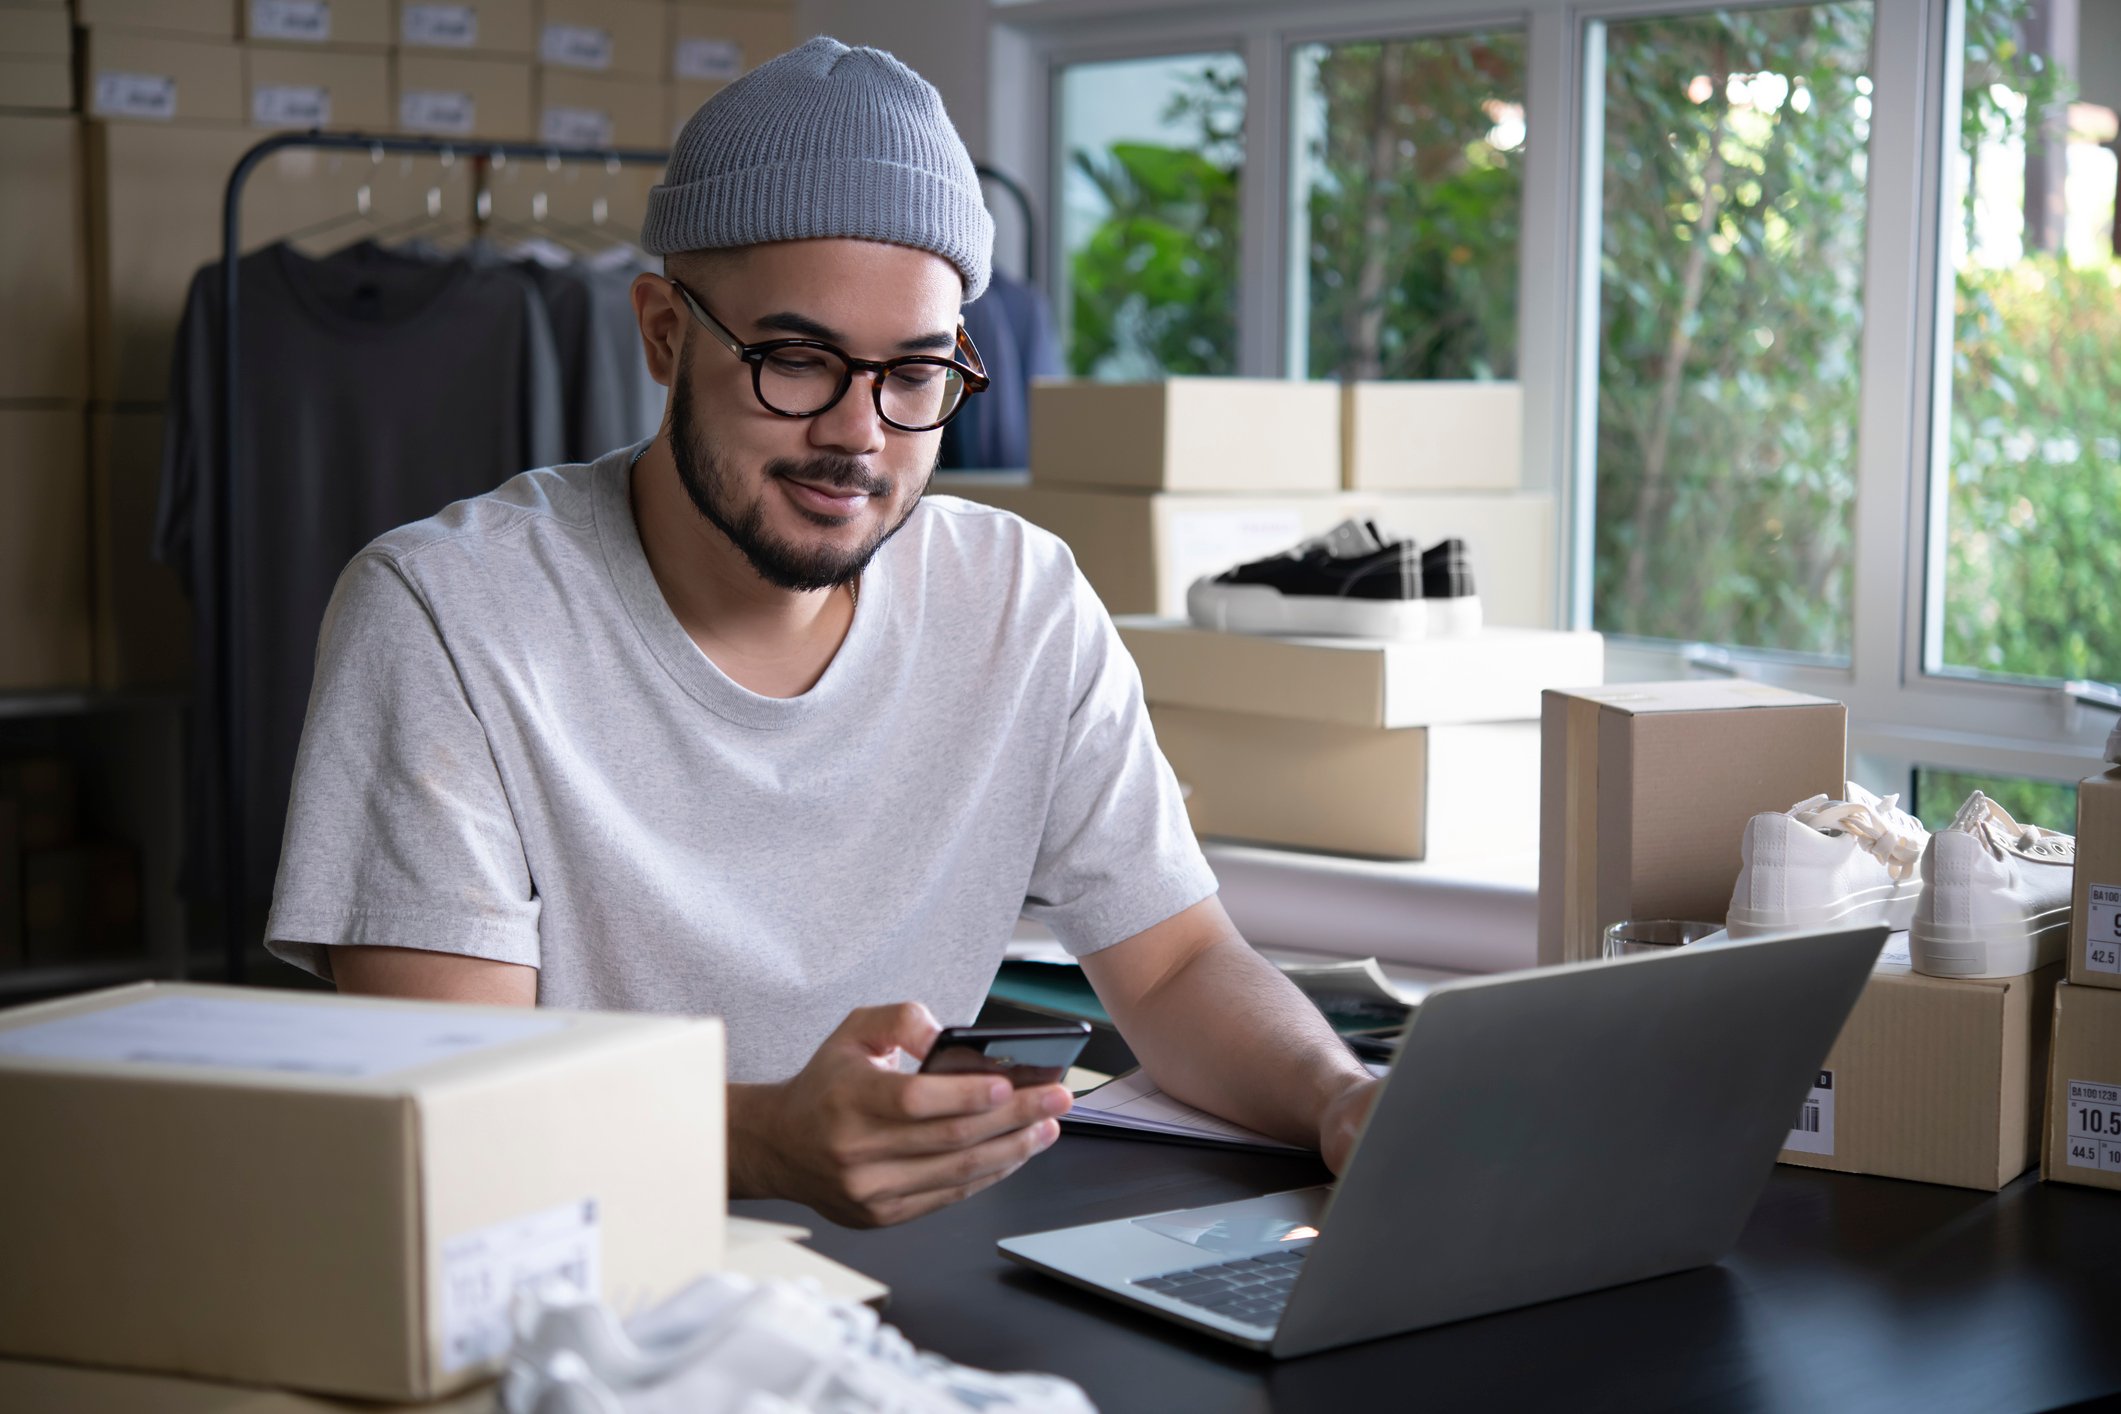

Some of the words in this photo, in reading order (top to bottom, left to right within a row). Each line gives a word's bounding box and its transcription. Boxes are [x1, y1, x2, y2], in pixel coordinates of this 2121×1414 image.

[2091, 950, 2115, 964] 42.5
[2079, 1108, 2121, 1135] 10.5
[2072, 1145, 2095, 1160] 44.5
